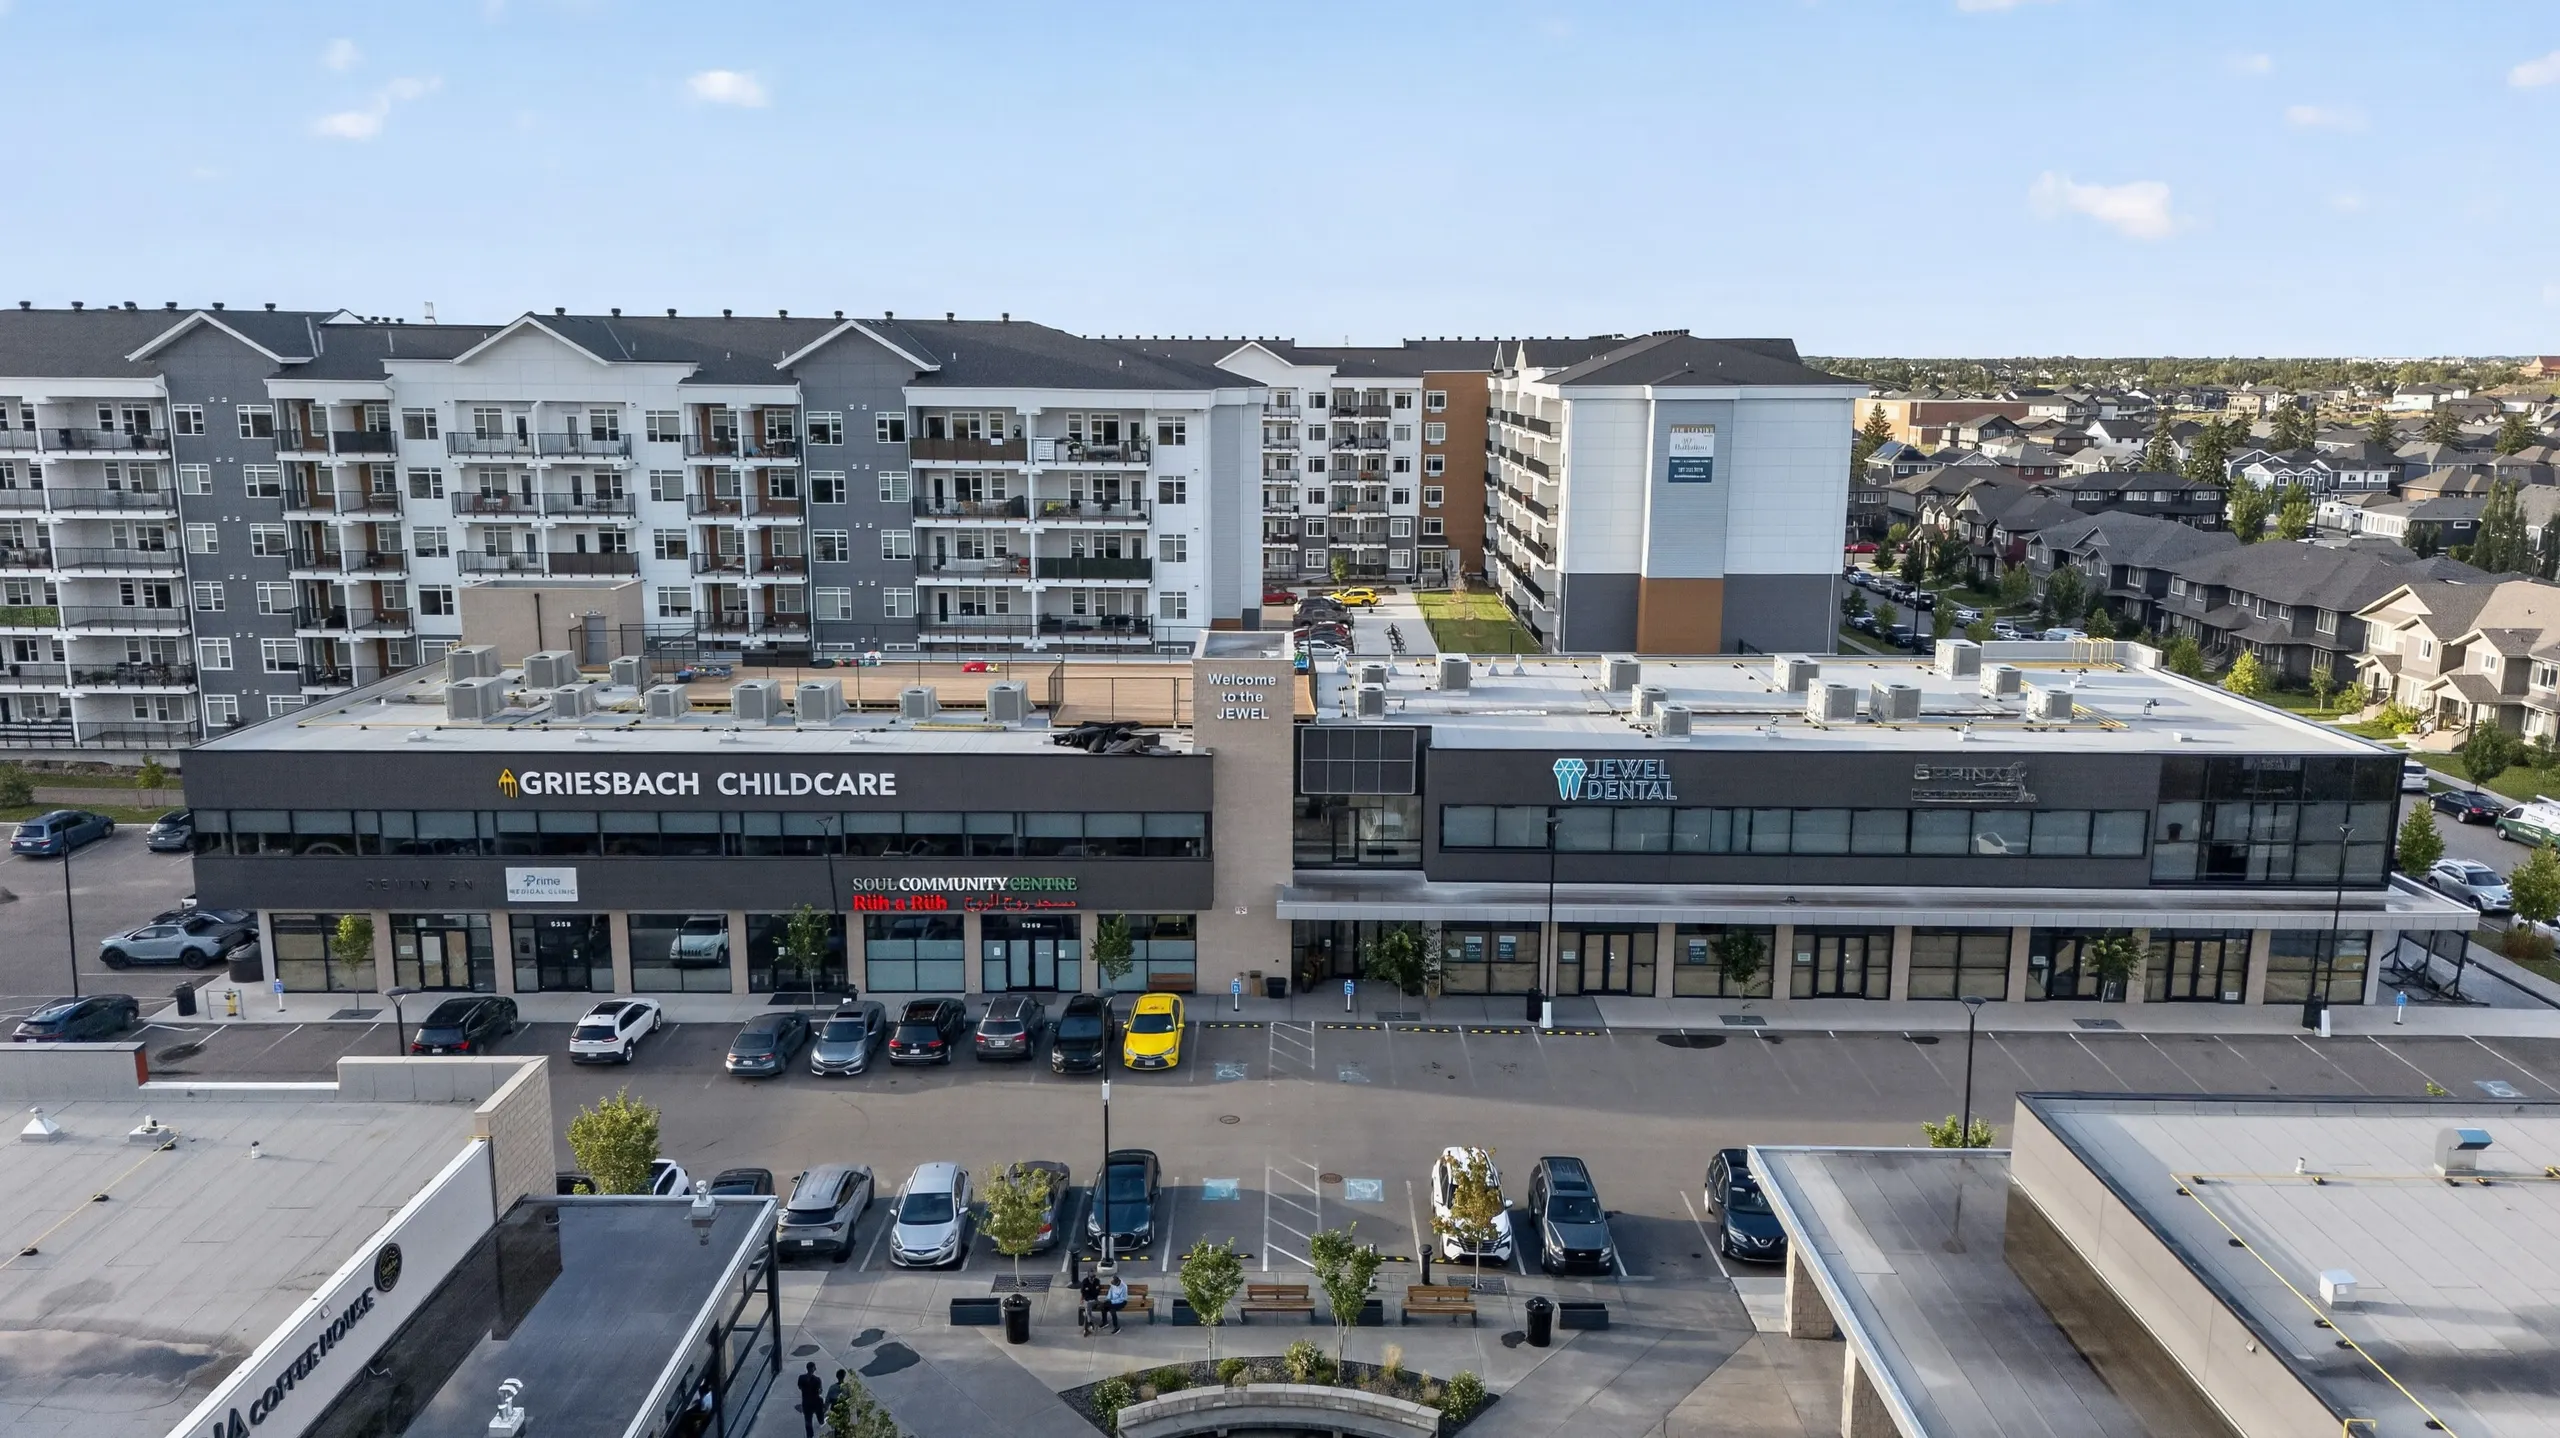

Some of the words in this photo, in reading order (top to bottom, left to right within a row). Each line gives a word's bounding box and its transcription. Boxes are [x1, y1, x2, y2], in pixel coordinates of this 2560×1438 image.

[1208, 673, 1277, 686] Welcome
[1222, 691, 1236, 703] to
[1240, 690, 1263, 703] the
[1216, 707, 1270, 720] JEWEL
[1588, 759, 1671, 779] JEWEL
[519, 771, 700, 796] GRIESBACH
[716, 772, 897, 797] CHILDCARE
[1587, 780, 1678, 800] DENTAL
[523, 874, 561, 887] Prime
[853, 877, 897, 891] SOUL
[899, 877, 1008, 891] COMMUNITY
[1009, 877, 1078, 891] CENTRE
[895, 898, 906, 911] a
[249, 1342, 321, 1426] COFFEE
[318, 1286, 375, 1357] HOUSE
